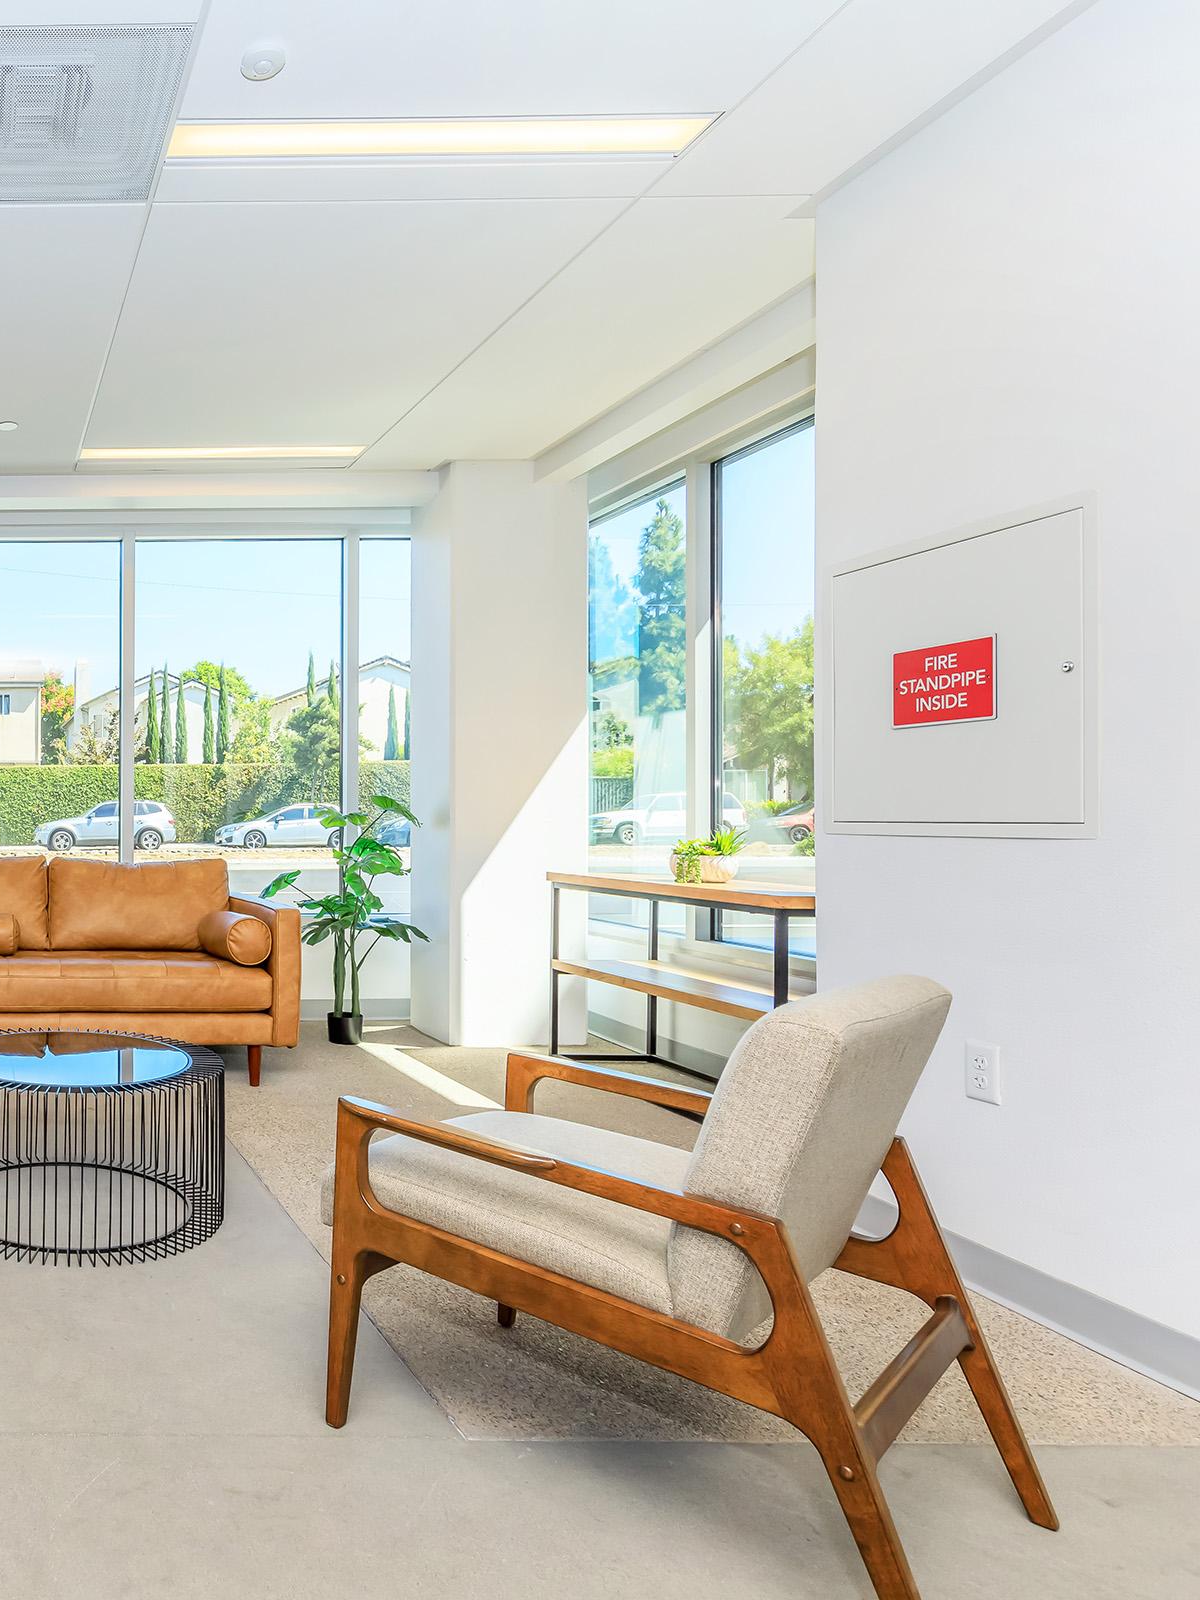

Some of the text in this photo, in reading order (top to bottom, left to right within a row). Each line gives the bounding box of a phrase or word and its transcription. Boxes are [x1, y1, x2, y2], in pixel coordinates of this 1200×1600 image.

[924, 653, 958, 672] FIRE
[899, 669, 986, 695] STANDPIPE
[915, 692, 968, 712] INSIDE
